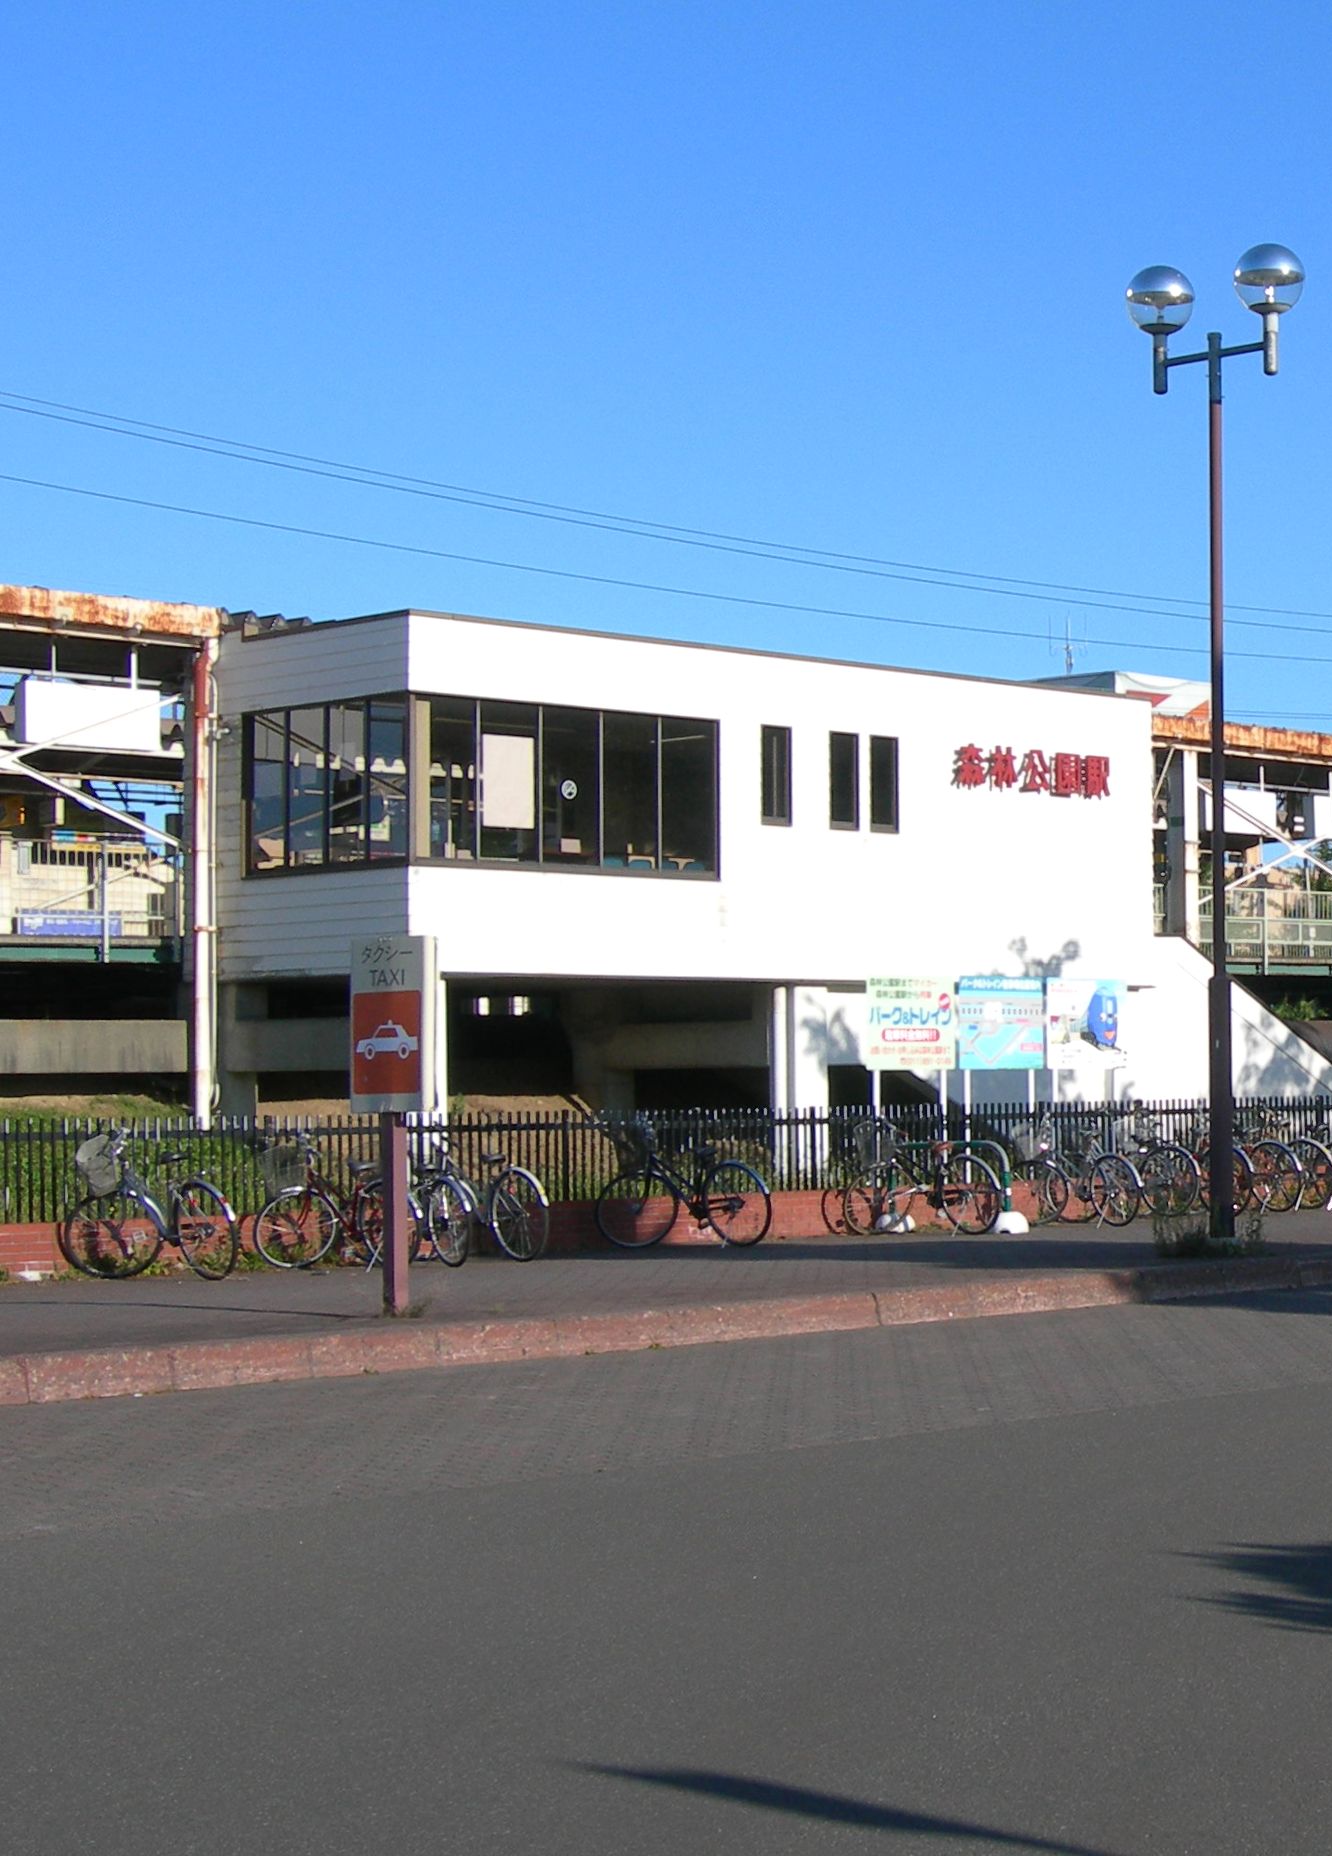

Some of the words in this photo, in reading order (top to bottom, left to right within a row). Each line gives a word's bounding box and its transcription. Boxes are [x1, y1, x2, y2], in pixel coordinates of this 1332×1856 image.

[951, 743, 1110, 800] 森林公園駅
[362, 945, 412, 964] タクシー
[369, 968, 405, 987] TAXI
